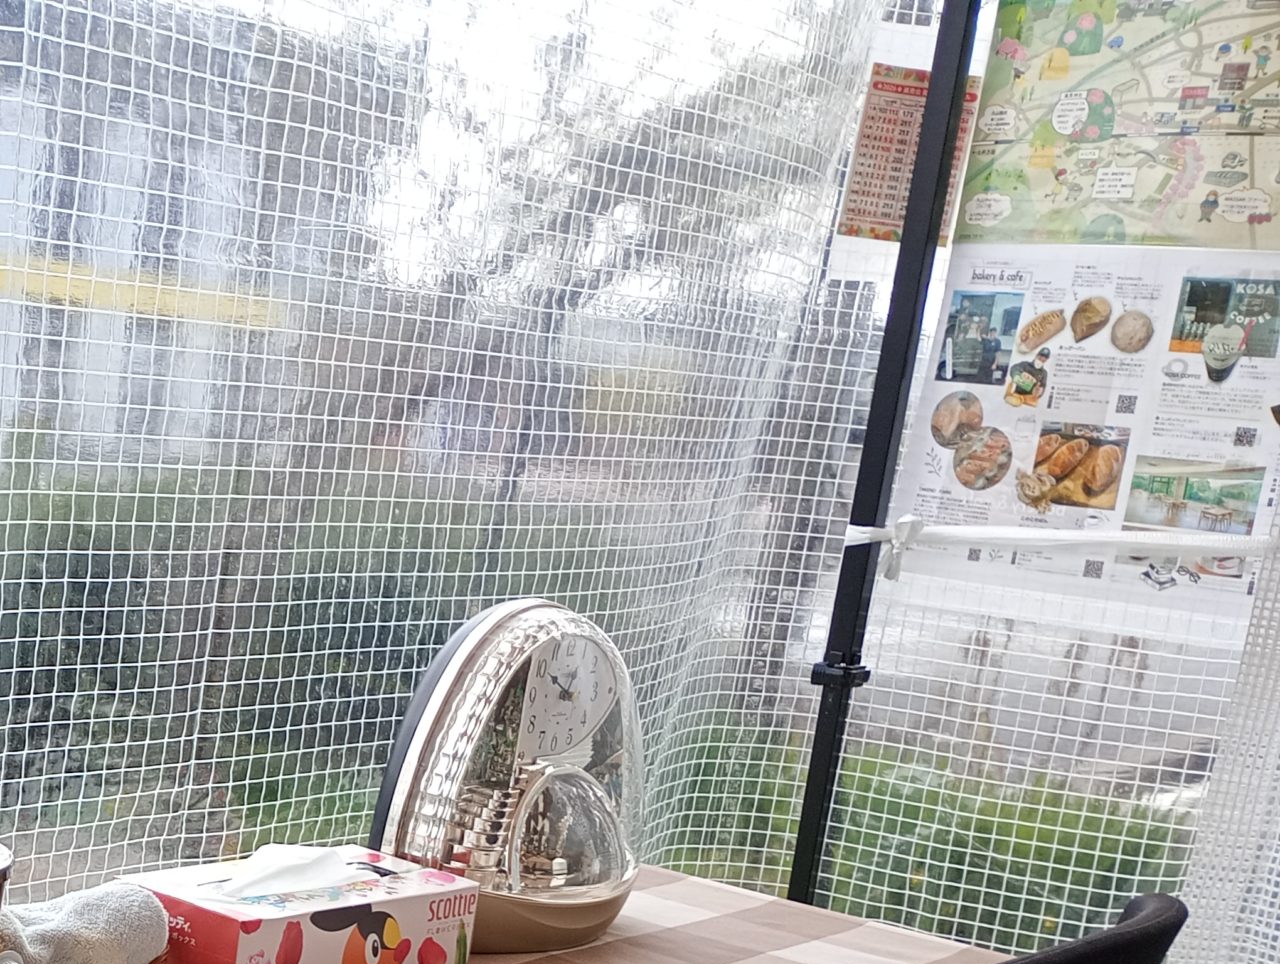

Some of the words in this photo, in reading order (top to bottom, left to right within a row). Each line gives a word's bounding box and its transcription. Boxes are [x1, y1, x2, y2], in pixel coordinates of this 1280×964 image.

[971, 268, 996, 286] bakery
[999, 269, 1006, 281] &
[1235, 282, 1276, 296] KOSA
[551, 642, 561, 662] 11
[566, 639, 577, 657] 12
[582, 641, 588, 660] 1
[535, 658, 548, 678] 10
[590, 655, 598, 674] 2
[529, 686, 537, 708] 9
[590, 681, 599, 702] 3
[527, 714, 537, 734] 8
[580, 709, 587, 728] 4
[538, 730, 547, 750] 7
[550, 732, 558, 752] 6
[565, 727, 574, 746] 5
